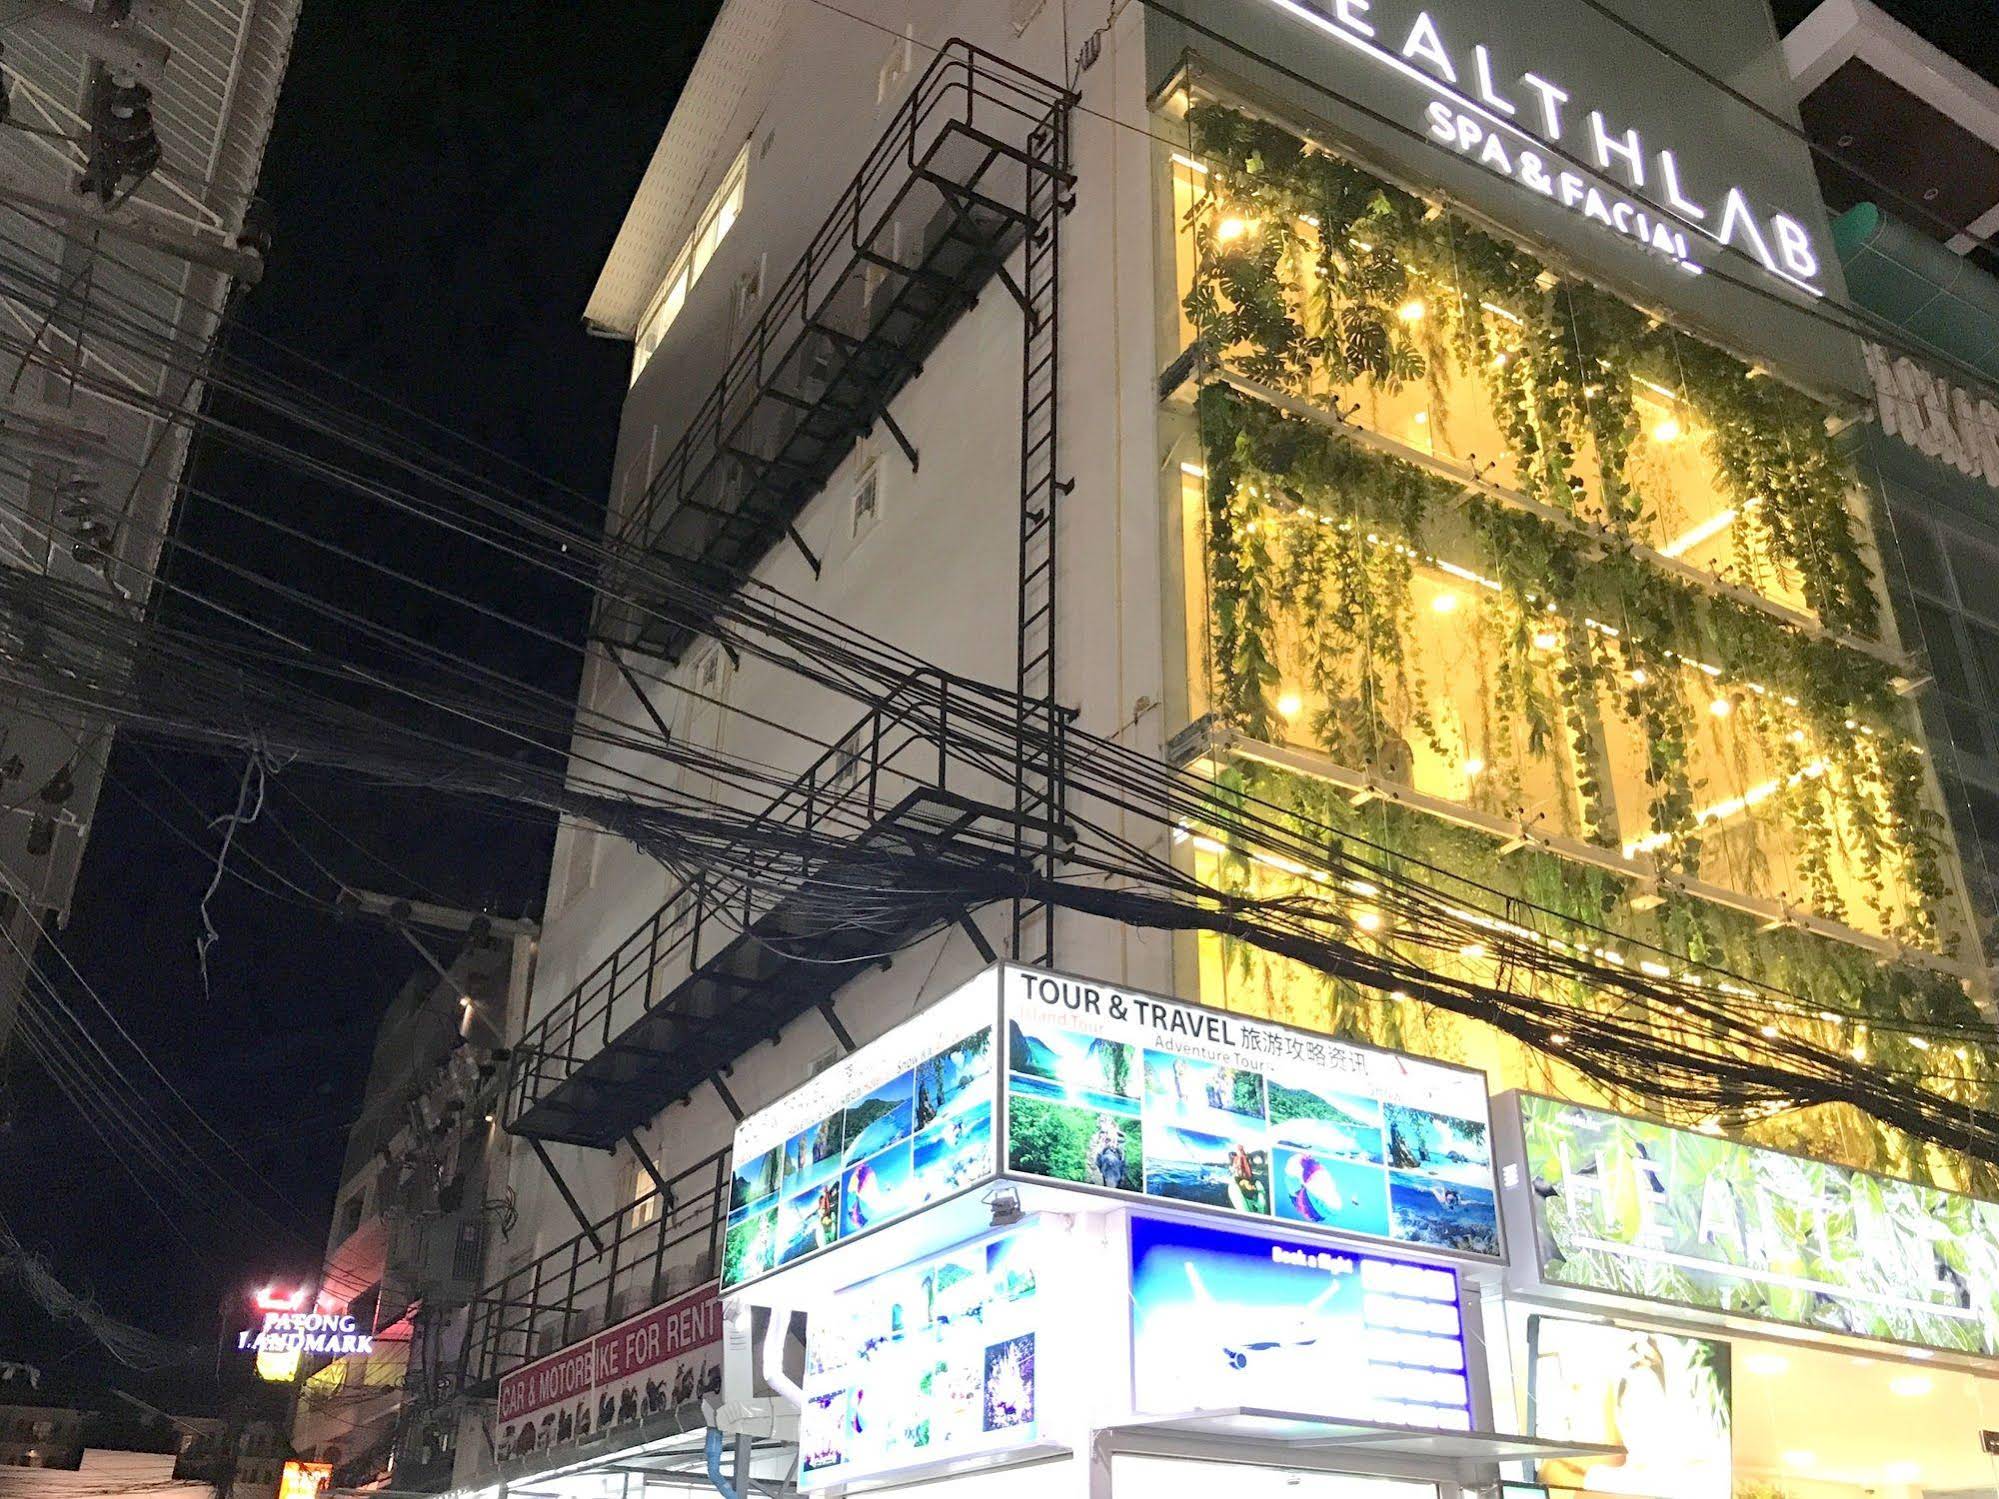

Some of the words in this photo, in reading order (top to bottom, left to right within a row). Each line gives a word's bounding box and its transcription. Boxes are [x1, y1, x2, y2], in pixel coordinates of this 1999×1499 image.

[1428, 100, 1513, 174] SPA
[1519, 150, 1553, 196] &
[1560, 171, 1703, 275] FACIAL
[1020, 973, 1101, 1016] TOUR
[1108, 994, 1128, 1022] &
[1133, 999, 1236, 1047] TRAVEL
[1154, 1035, 1231, 1062] Adventure
[238, 1331, 374, 1353] LANDMARK
[263, 1312, 356, 1333] PATONG
[501, 1380, 525, 1417] CAR
[528, 1378, 536, 1402] &
[539, 1340, 620, 1404] MOTORBIKE
[626, 1322, 660, 1369] FOR
[666, 1300, 718, 1352] RENT
